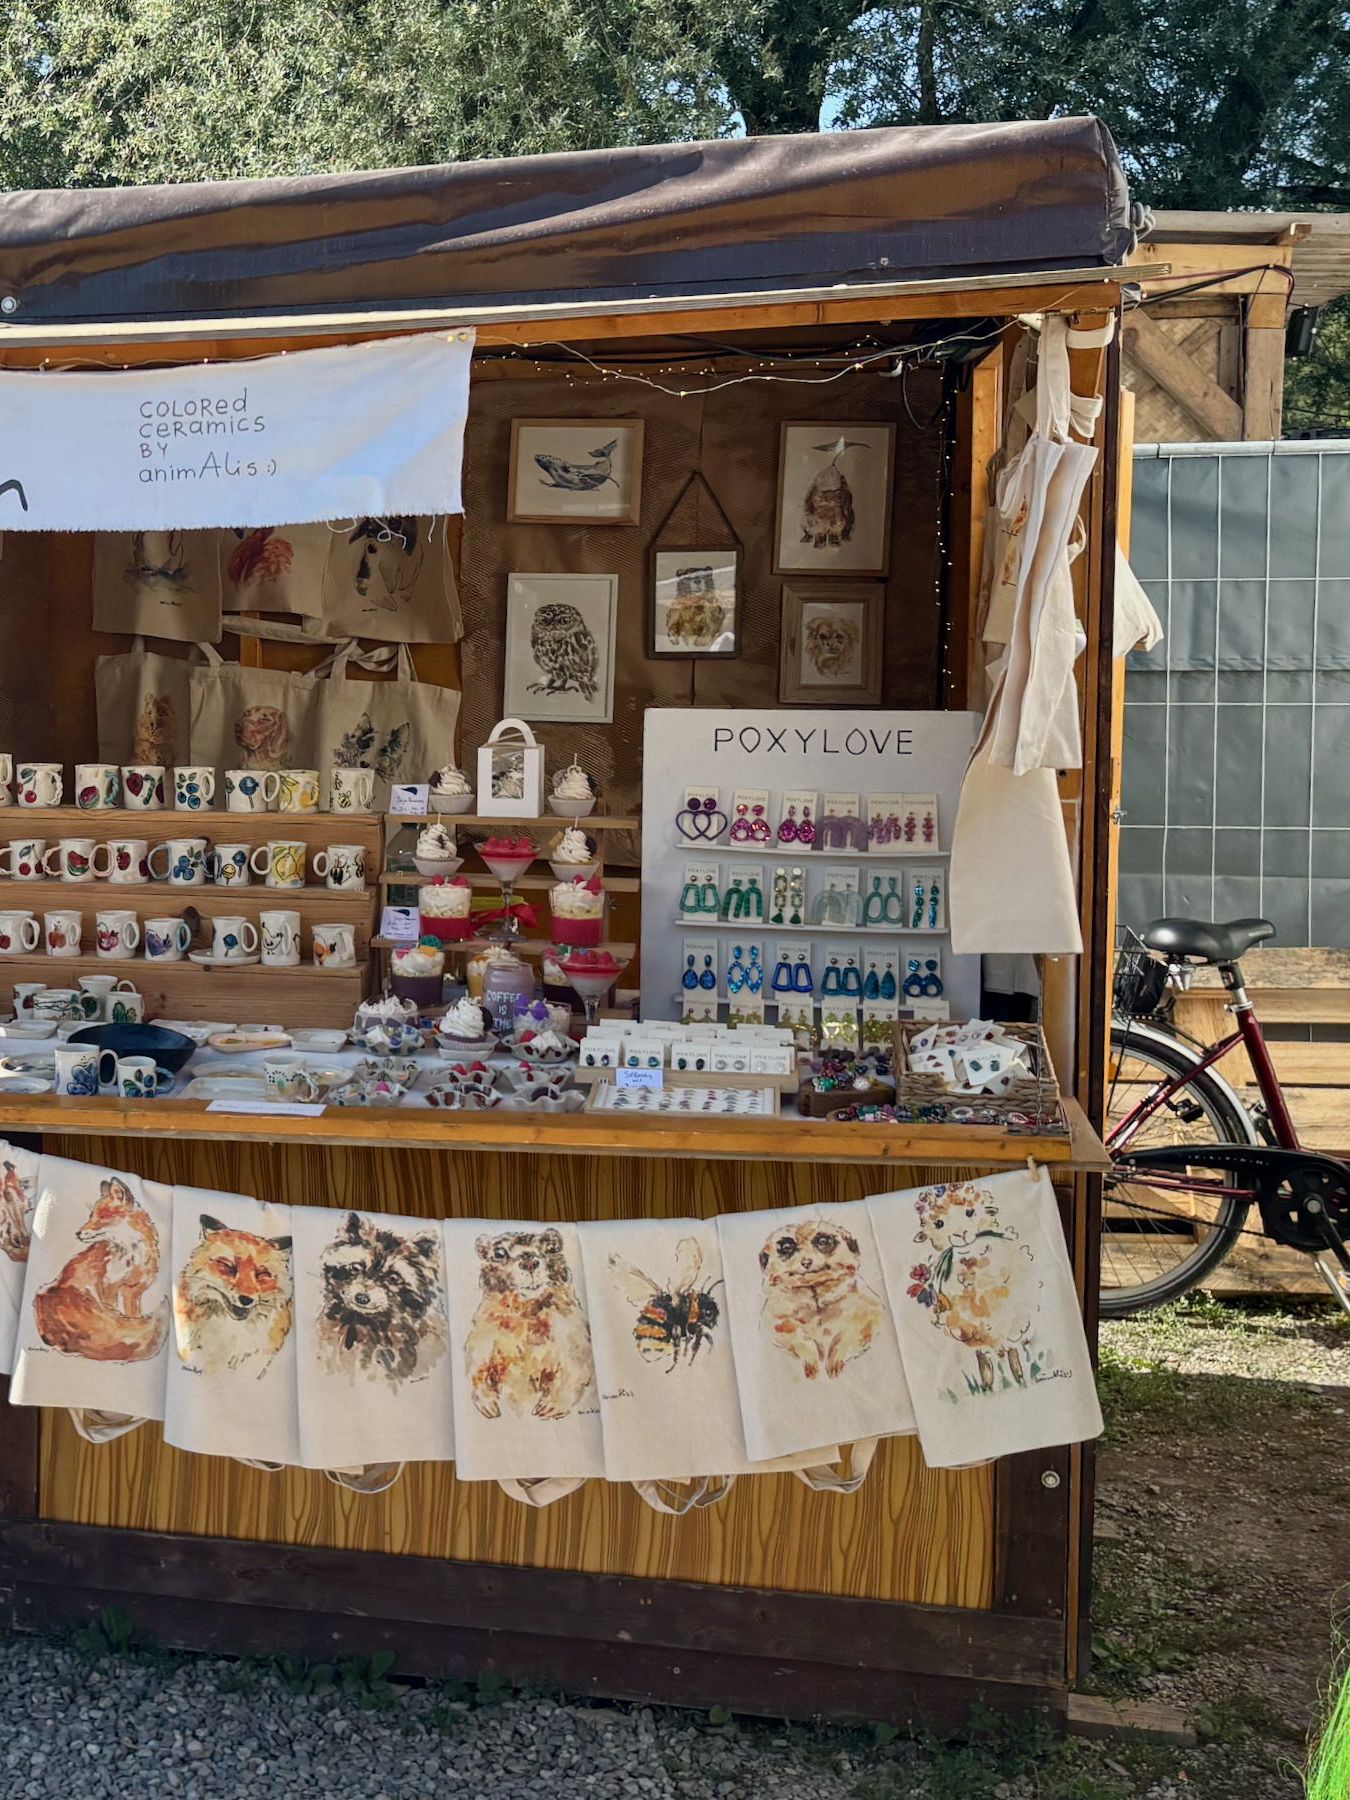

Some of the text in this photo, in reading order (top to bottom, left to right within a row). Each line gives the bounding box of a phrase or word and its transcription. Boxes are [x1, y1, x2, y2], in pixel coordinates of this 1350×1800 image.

[714, 726, 913, 756] POXYLOVE
[498, 1004, 507, 1015] IS
[493, 1018, 512, 1029] THE
